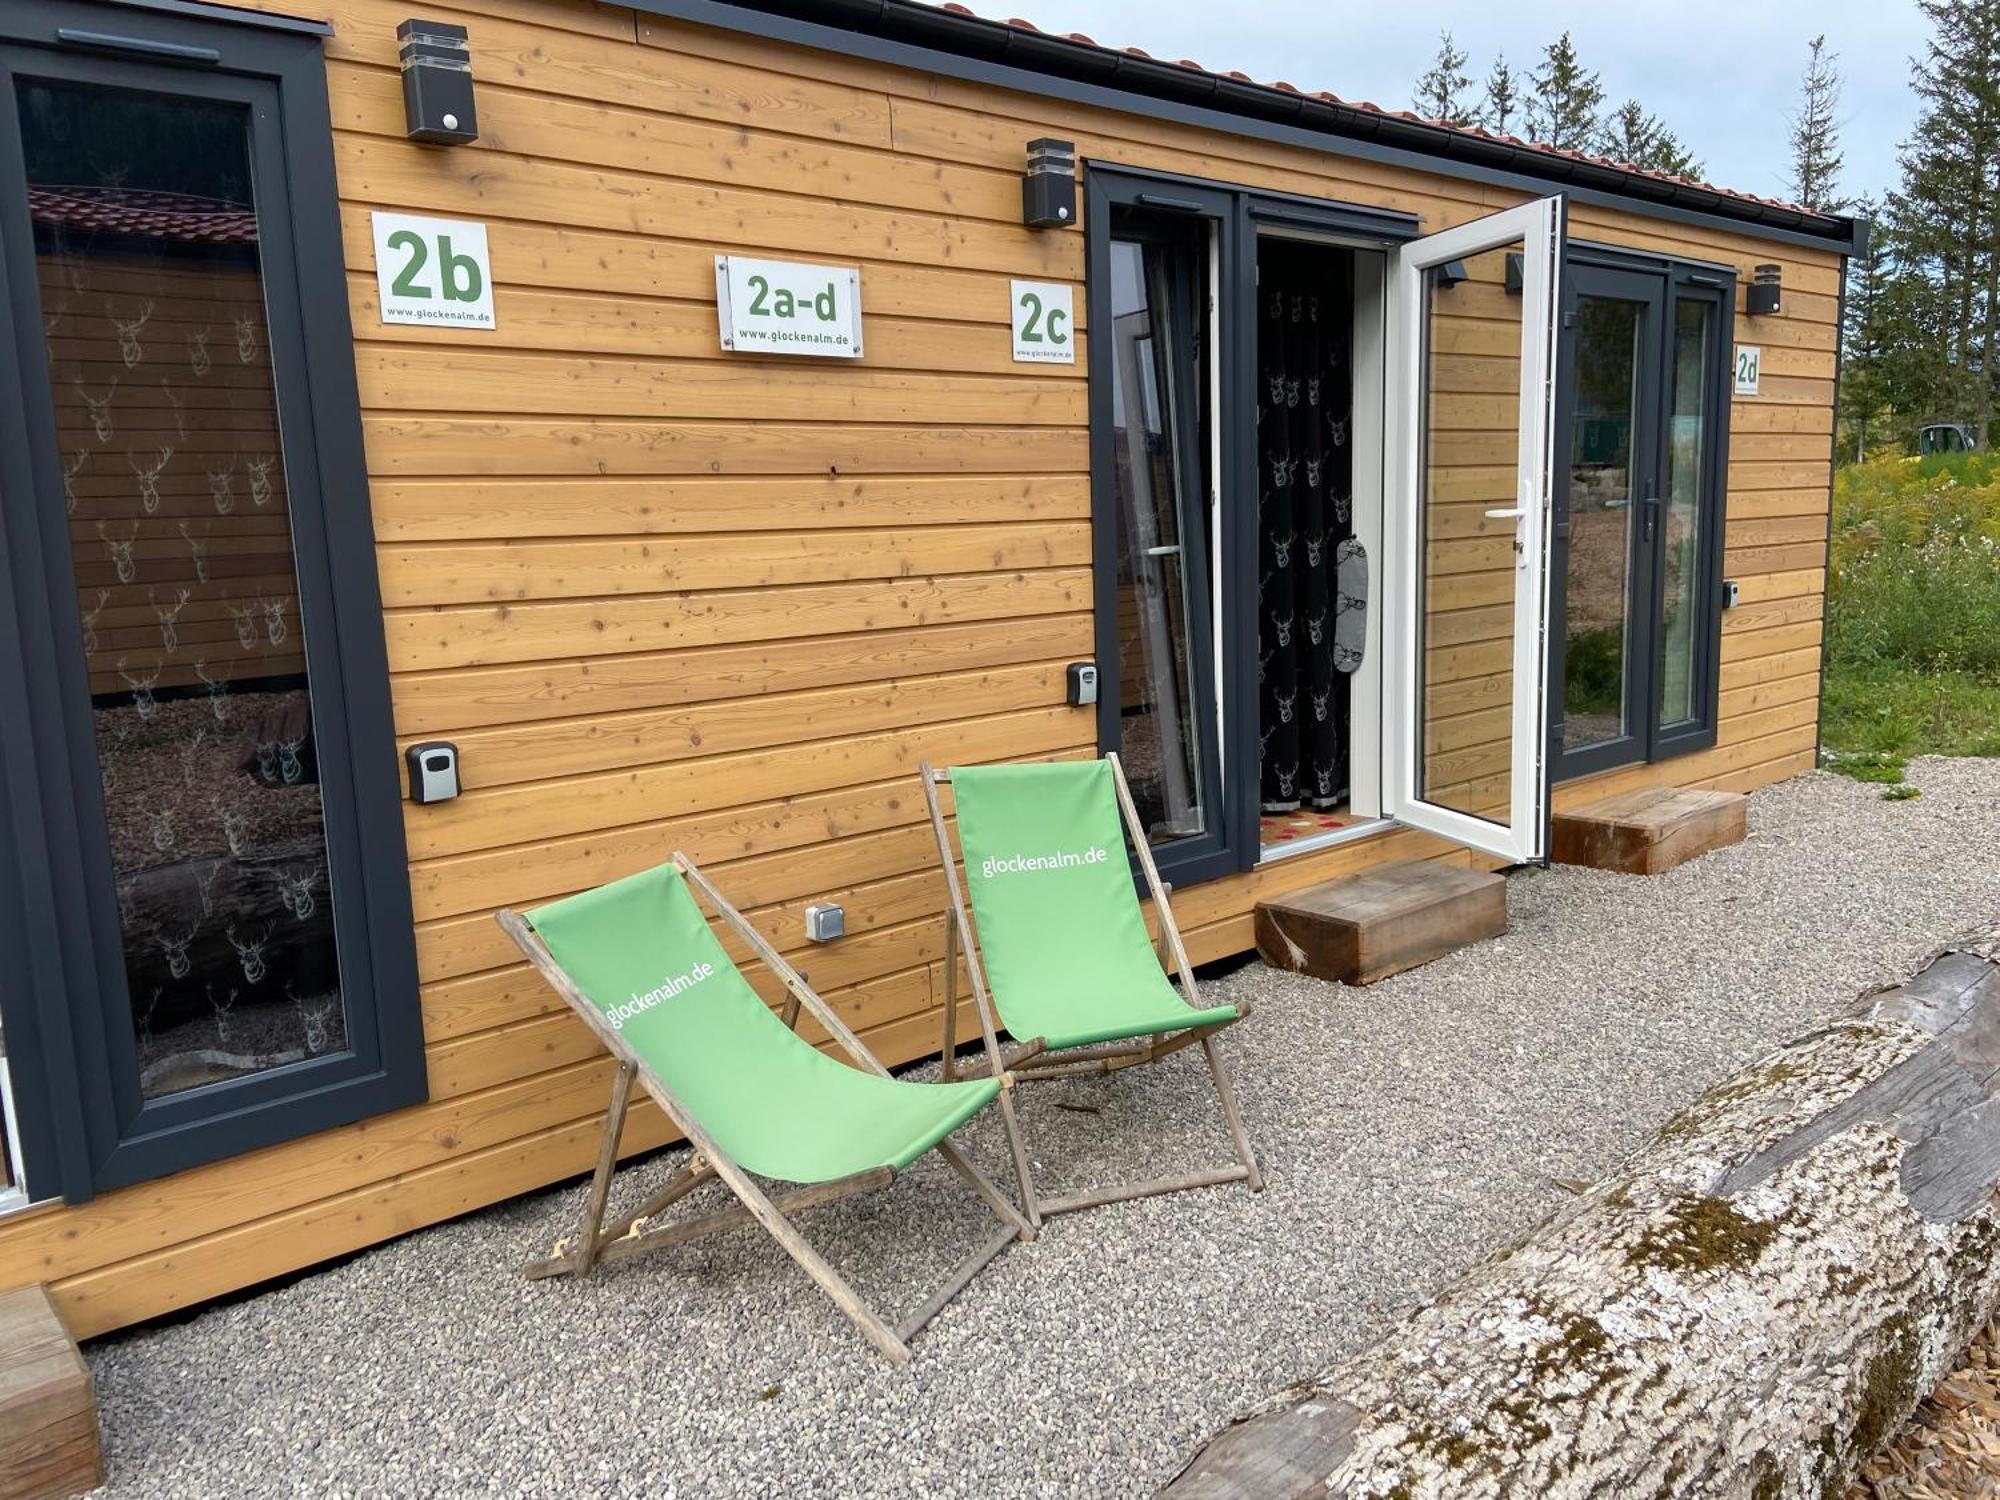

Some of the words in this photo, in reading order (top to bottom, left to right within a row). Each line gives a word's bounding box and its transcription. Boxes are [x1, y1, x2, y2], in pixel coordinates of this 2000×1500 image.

[387, 230, 483, 303] 2b
[387, 307, 490, 323] www.glockenalm.de
[748, 275, 836, 322] 2a-d
[1020, 292, 1067, 344] 2c
[739, 329, 849, 345] www.glockenalm.de
[1737, 352, 1758, 383] 2d
[982, 846, 1107, 879] glockenalm.de
[606, 961, 714, 1029] glockenalm.de
